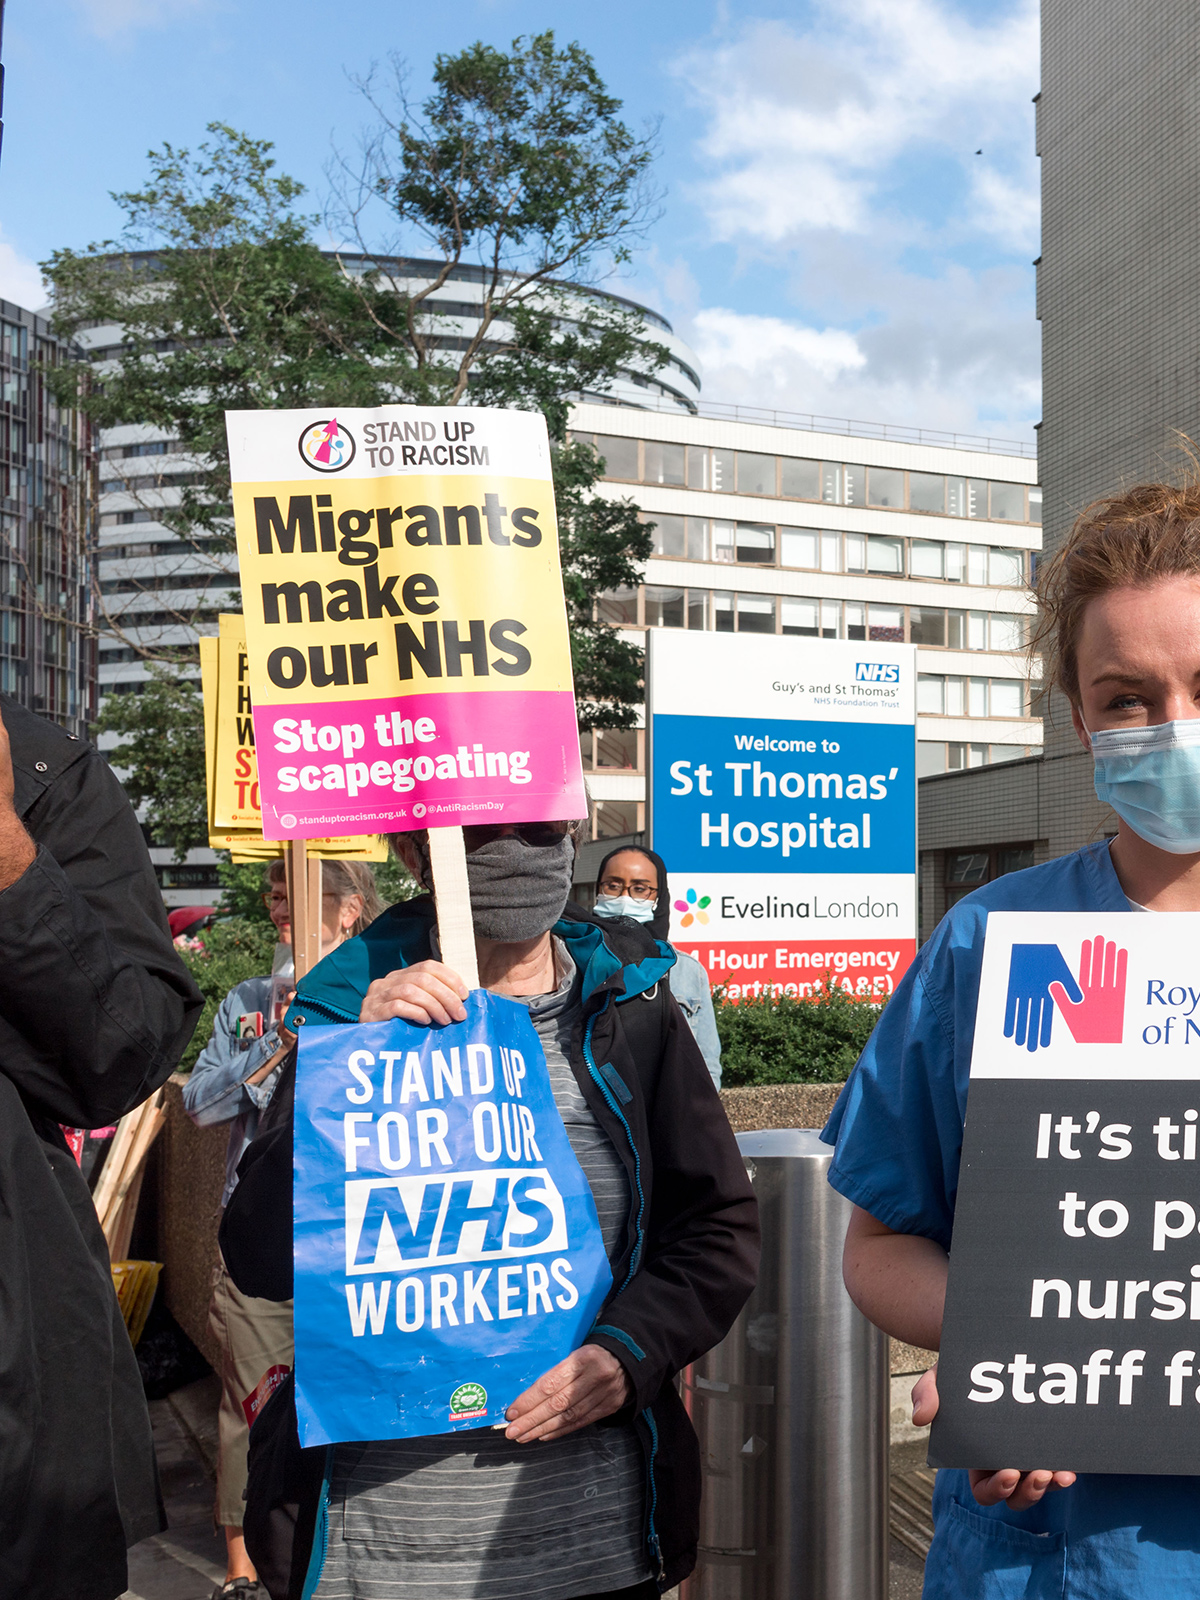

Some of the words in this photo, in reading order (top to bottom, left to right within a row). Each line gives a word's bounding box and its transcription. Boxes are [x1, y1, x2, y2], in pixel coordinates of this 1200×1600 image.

[362, 421, 437, 445] STAND
[442, 421, 476, 443] UP
[364, 446, 395, 469] TO
[401, 445, 490, 467] RACISM
[252, 492, 543, 567] Migrants
[260, 563, 440, 625] make
[266, 642, 378, 690] our
[394, 618, 533, 682] NHS
[856, 663, 899, 682] NHS
[808, 683, 831, 694] and
[835, 684, 847, 695] St
[813, 697, 831, 705] NHS
[833, 697, 878, 707] Foundation
[881, 700, 900, 708] Trust
[271, 717, 366, 760] Stop
[374, 711, 438, 747] the
[733, 735, 817, 754] Welcome
[821, 738, 841, 754] to
[276, 743, 533, 798] scapegoating
[669, 760, 713, 797] St
[298, 809, 407, 827] standuptoracism.org.uk
[427, 802, 505, 814] @AntiRacismDay
[700, 812, 872, 857] Hospital
[720, 895, 810, 920] Evelina
[814, 895, 899, 919] London
[709, 949, 768, 970] Hour
[775, 948, 901, 972] Emergency
[1141, 1016, 1175, 1046] of
[345, 1042, 495, 1105] STAND
[499, 1044, 527, 1098] UP
[344, 1107, 453, 1173] FOR
[472, 1100, 544, 1163] OUR
[353, 1176, 556, 1266] NHS
[1058, 1191, 1129, 1239] to
[344, 1257, 579, 1338] WORKERS
[967, 1348, 1145, 1406] staff
